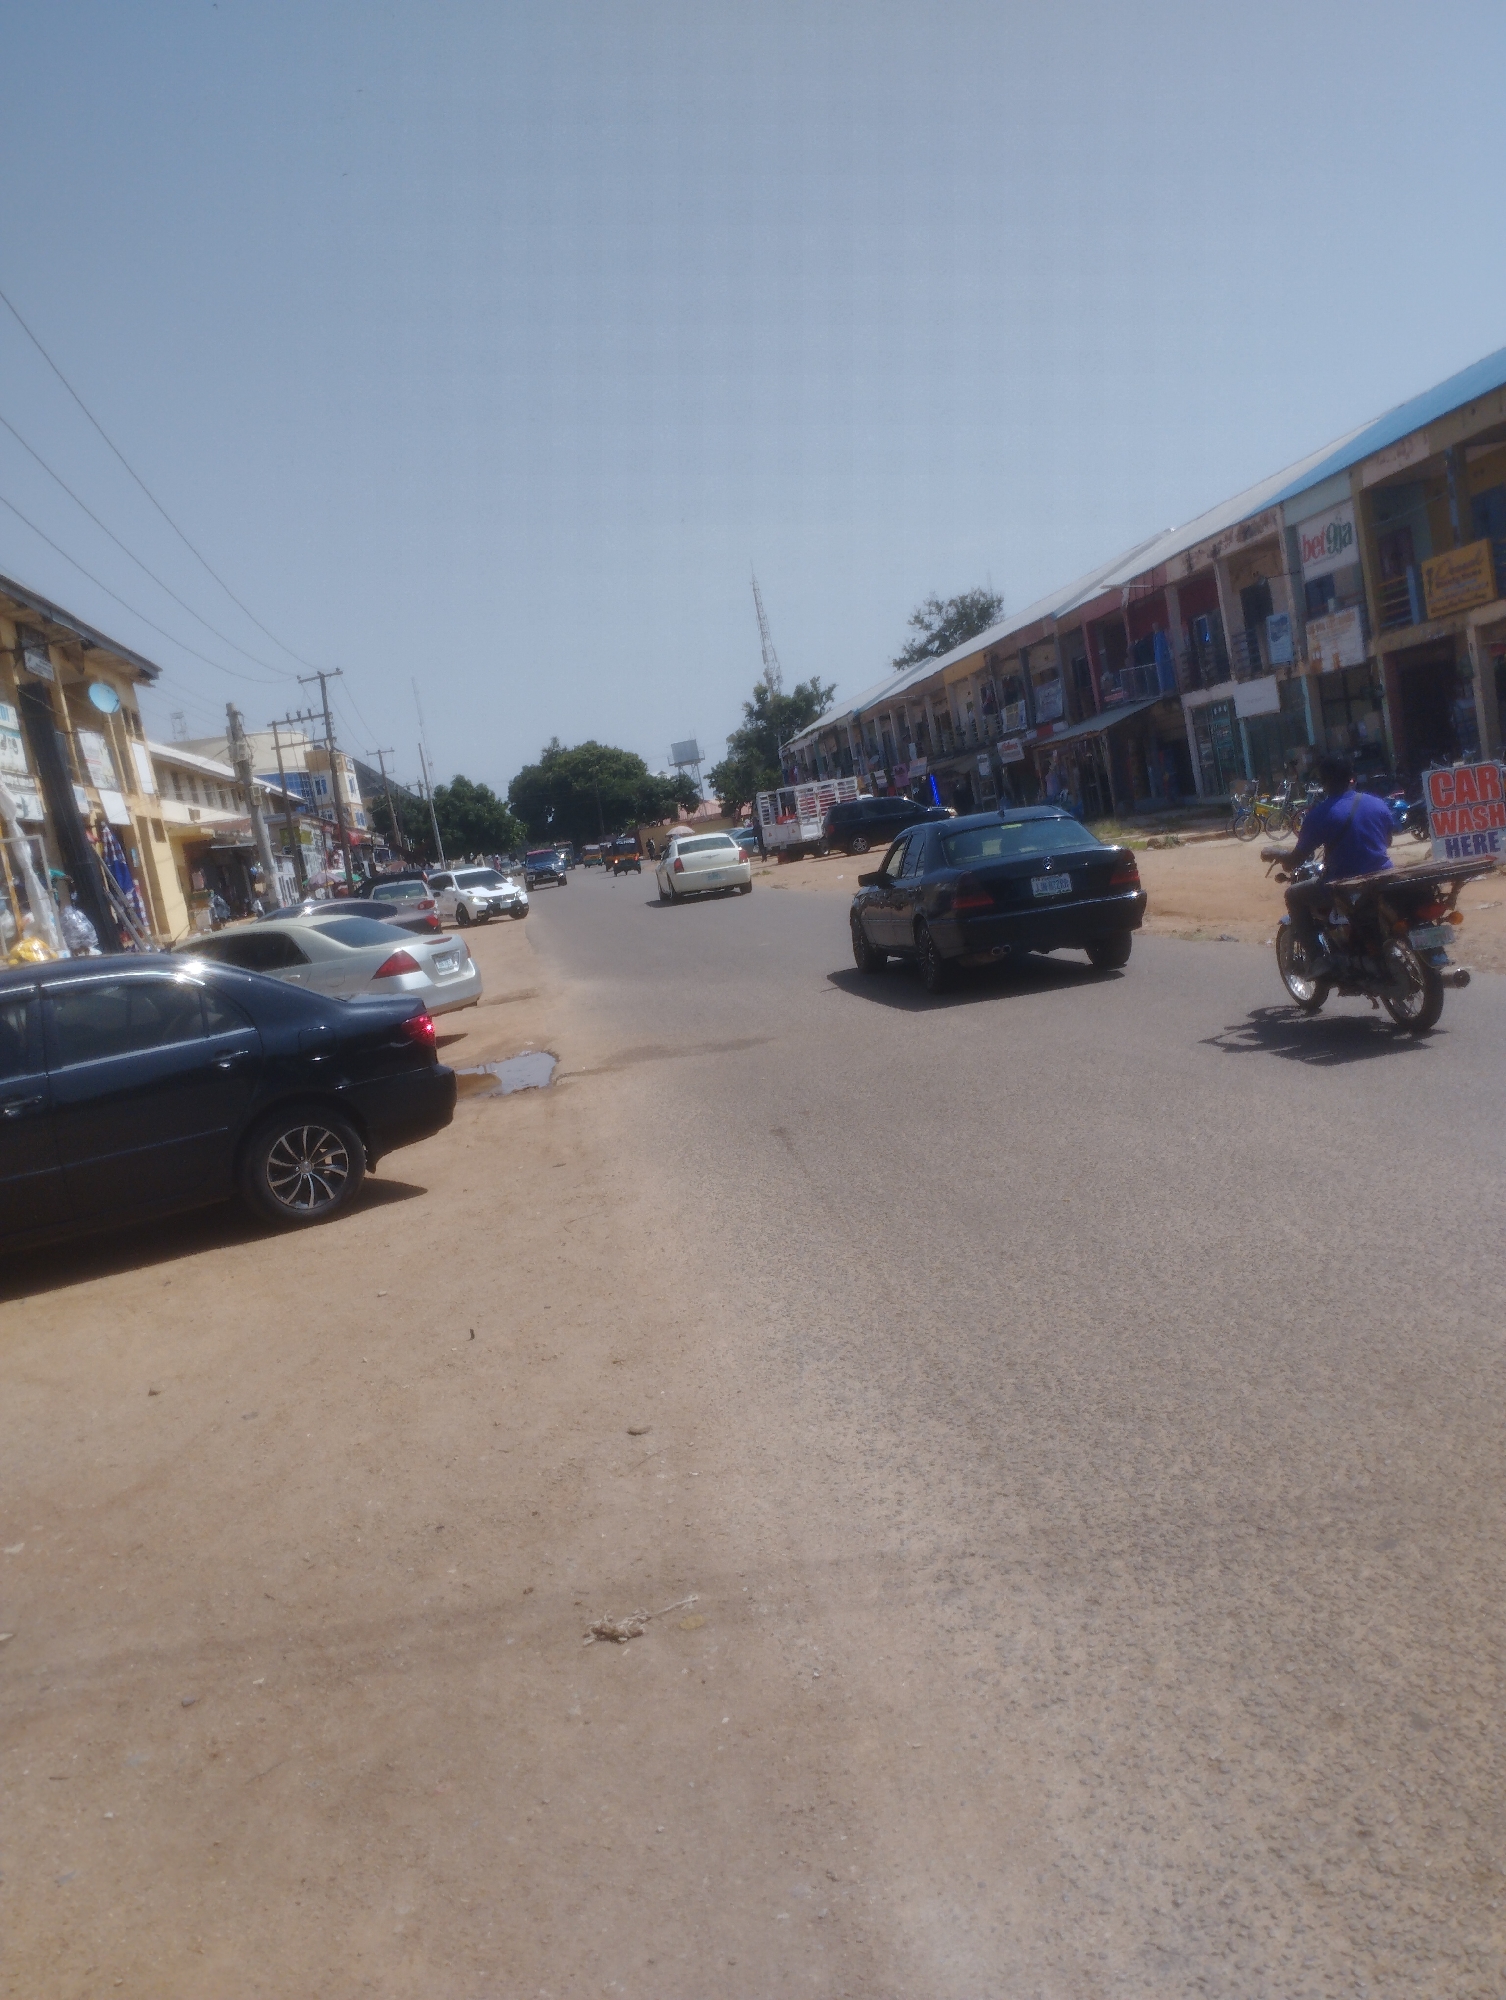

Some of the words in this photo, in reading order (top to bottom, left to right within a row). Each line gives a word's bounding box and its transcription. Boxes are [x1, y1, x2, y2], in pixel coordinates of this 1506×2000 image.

[1429, 765, 1501, 809] CAR
[1430, 802, 1506, 837] WASH
[1445, 832, 1501, 859] HERE
